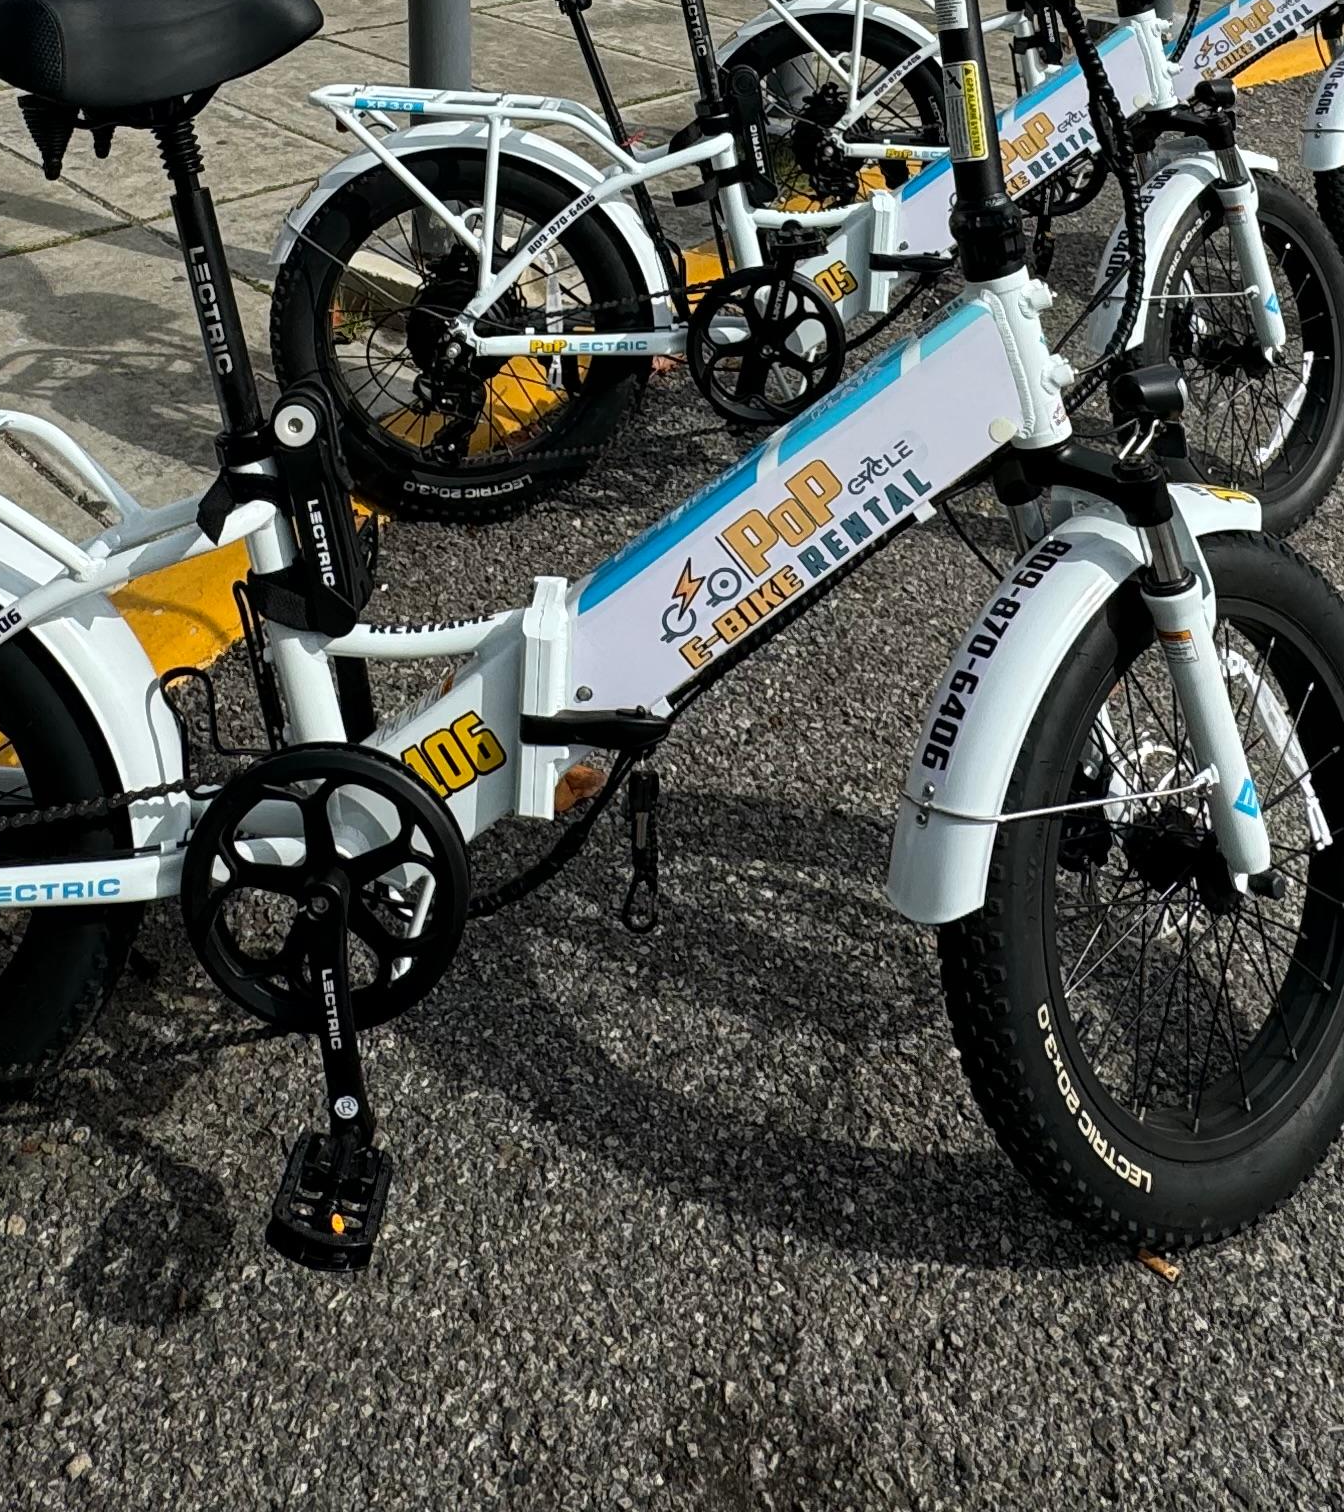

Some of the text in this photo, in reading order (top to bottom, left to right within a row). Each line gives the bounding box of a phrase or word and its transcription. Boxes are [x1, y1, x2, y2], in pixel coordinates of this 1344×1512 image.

[1254, 4, 1313, 47] RENTAL
[749, 124, 766, 175] LECTRIC
[1027, 125, 1095, 179] RENTA
[1057, 106, 1089, 134] CYCL
[527, 192, 596, 255] 809-870-6406
[188, 245, 234, 377] LECTRIC
[529, 339, 647, 354] PoP LECTRIC
[403, 473, 533, 499] LECTRIC 20x3.0
[721, 459, 843, 578] PoP
[848, 439, 914, 495] CYCLE
[307, 498, 336, 588] LECTRIC
[679, 563, 805, 669] E-BIKE
[797, 468, 932, 578] RENTAL
[922, 541, 1072, 771] 809-870-6406
[400, 710, 507, 800] 106
[321, 968, 342, 1050] LECTRIC
[1037, 1003, 1153, 1194] LECTRIC 20x3.0
